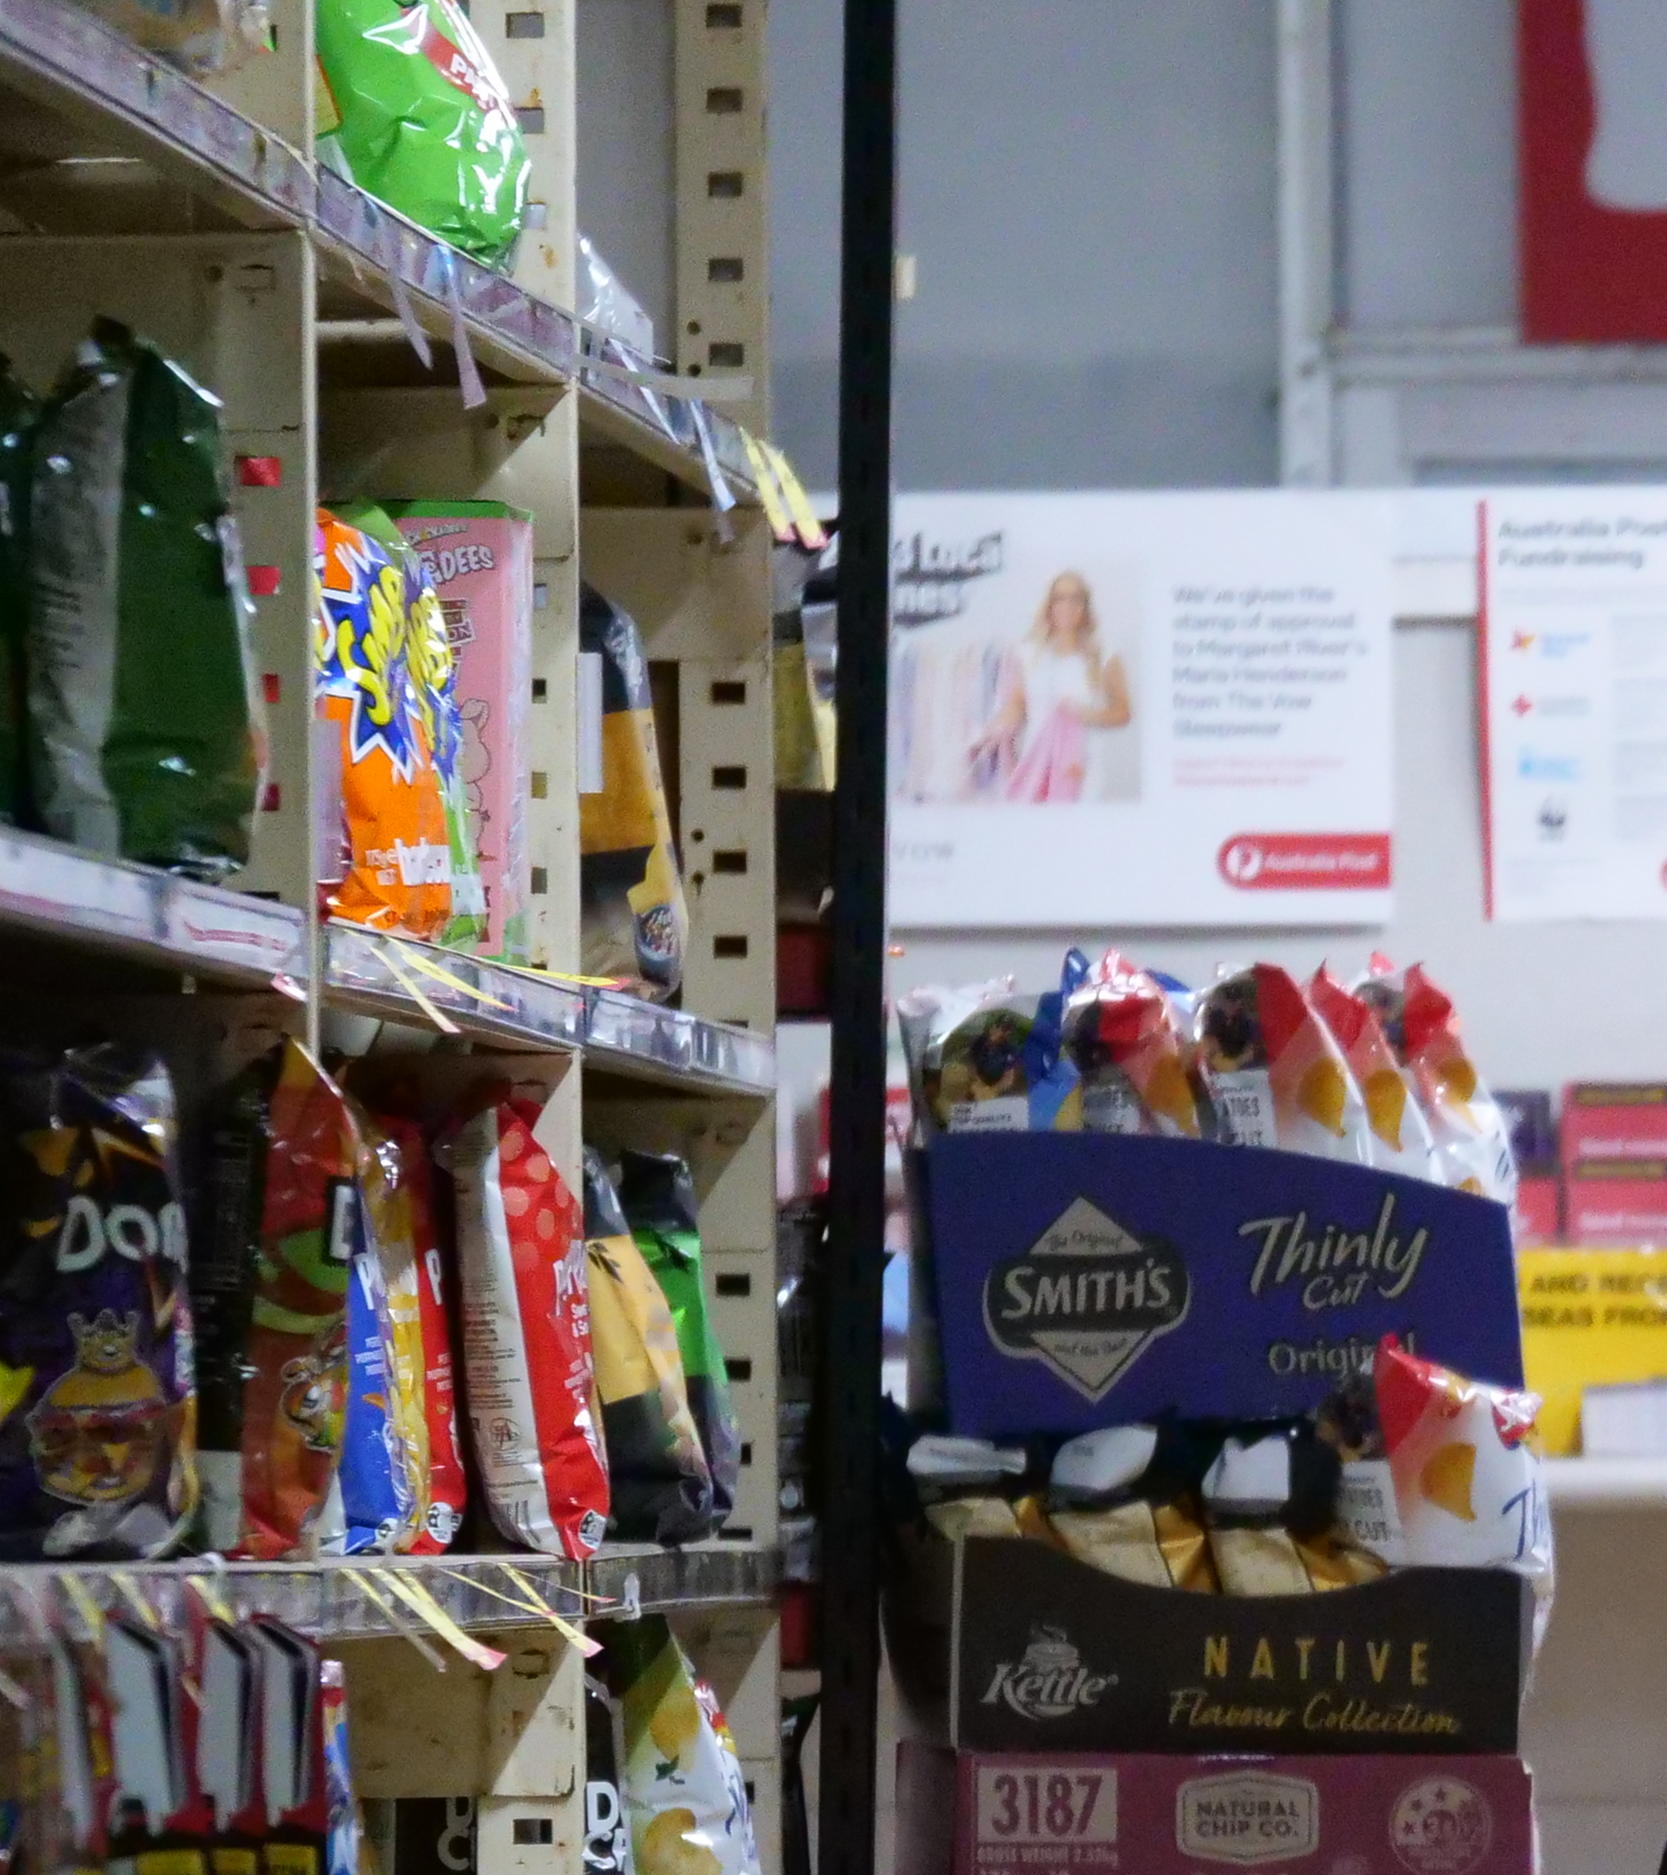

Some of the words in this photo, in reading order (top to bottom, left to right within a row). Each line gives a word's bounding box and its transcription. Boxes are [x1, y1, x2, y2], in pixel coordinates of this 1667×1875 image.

[1237, 1192, 1431, 1298] Thinly
[999, 1257, 1173, 1320] SMITH'S
[1302, 1273, 1371, 1311] Cut
[1203, 1635, 1431, 1686] NATIVE
[980, 1662, 1106, 1721] Kettle
[1301, 1693, 1464, 1736] Collection
[991, 1774, 1102, 1836] 3187
[1195, 1799, 1300, 1818] NATURAL
[1196, 1819, 1251, 1838] CHIP
[1259, 1819, 1299, 1838] CO.
